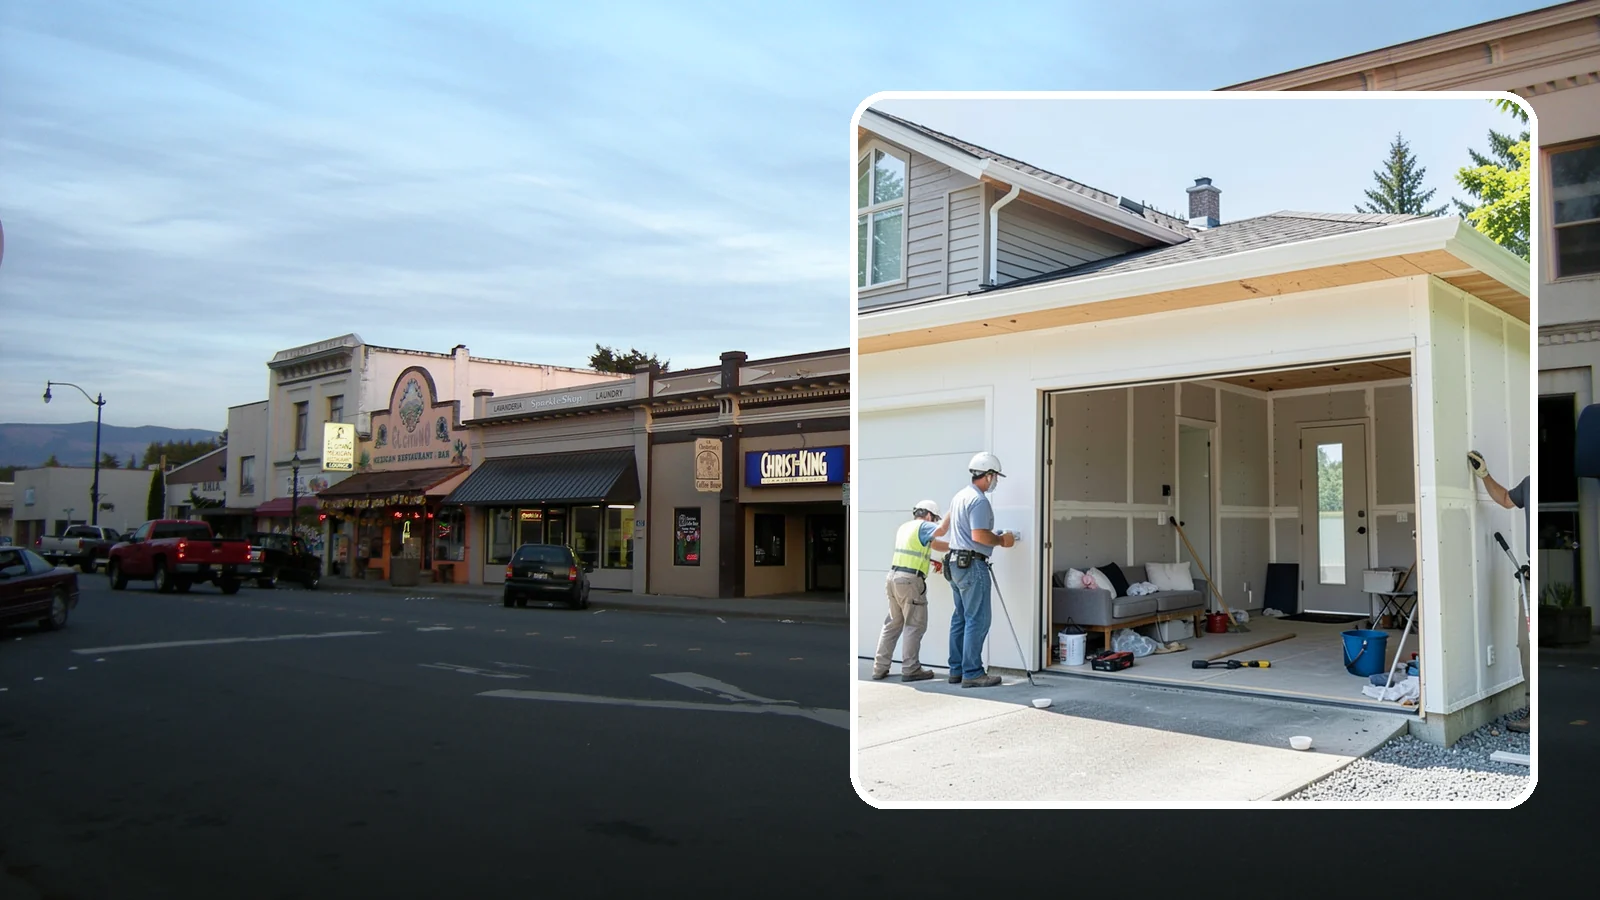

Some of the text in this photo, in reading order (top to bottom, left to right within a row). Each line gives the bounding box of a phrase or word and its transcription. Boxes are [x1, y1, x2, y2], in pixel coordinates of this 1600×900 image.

[494, 402, 522, 412] LAVANDERIA
[596, 389, 624, 400] LAUNDRY
[373, 450, 450, 464] MEXICAN RESTAURANT BAR
[760, 450, 827, 478] CHRIST KING
[697, 481, 722, 489] Coffee House
